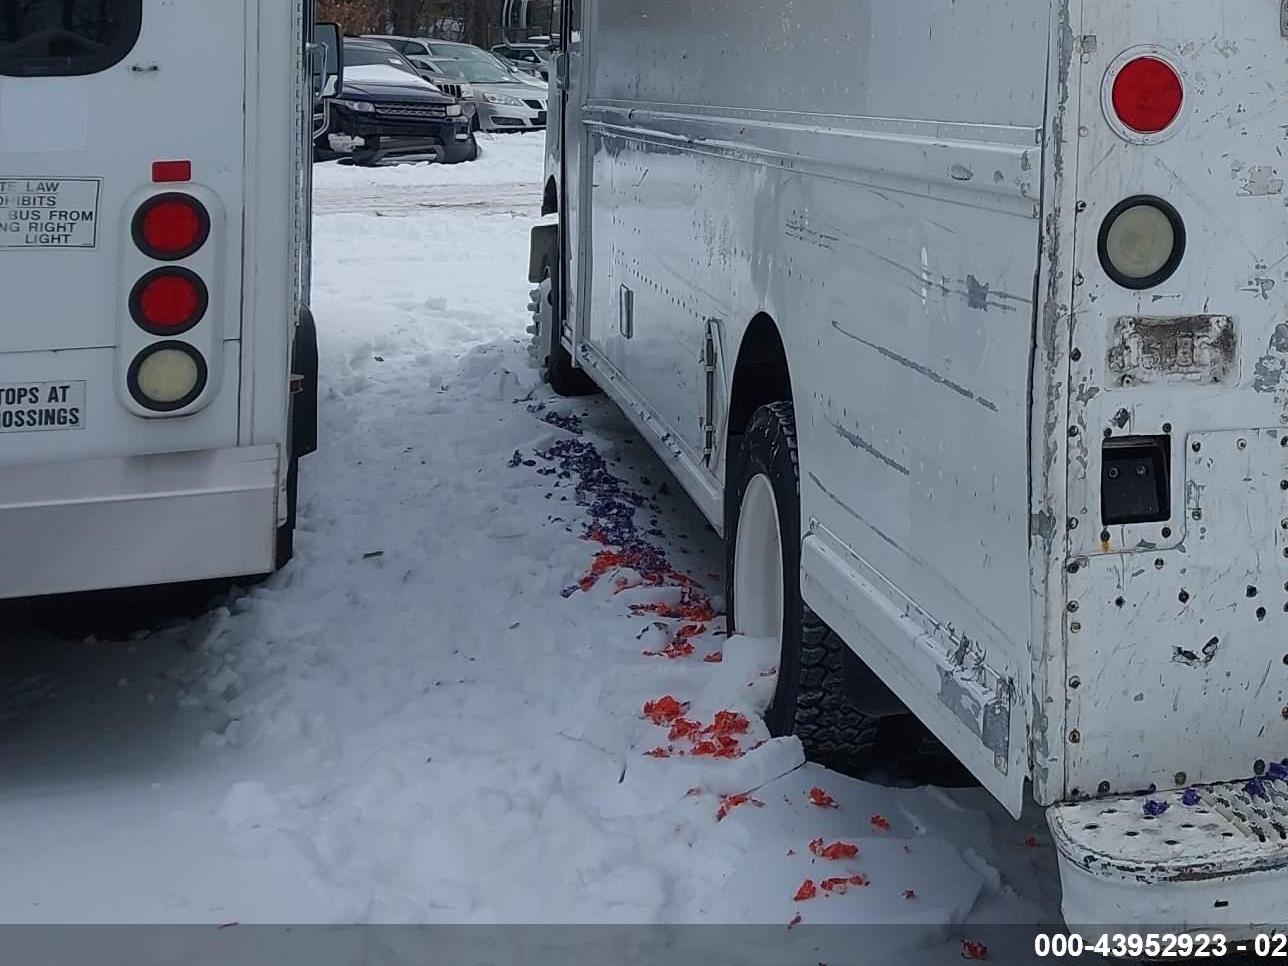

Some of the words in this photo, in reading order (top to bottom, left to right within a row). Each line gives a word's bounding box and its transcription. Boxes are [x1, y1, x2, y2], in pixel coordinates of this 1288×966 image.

[26, 182, 60, 192] LAW
[9, 210, 41, 221] BUS
[49, 210, 93, 221] FROM
[29, 222, 76, 232] RIGHT
[25, 234, 72, 244] LIGHT
[47, 385, 70, 403] AT
